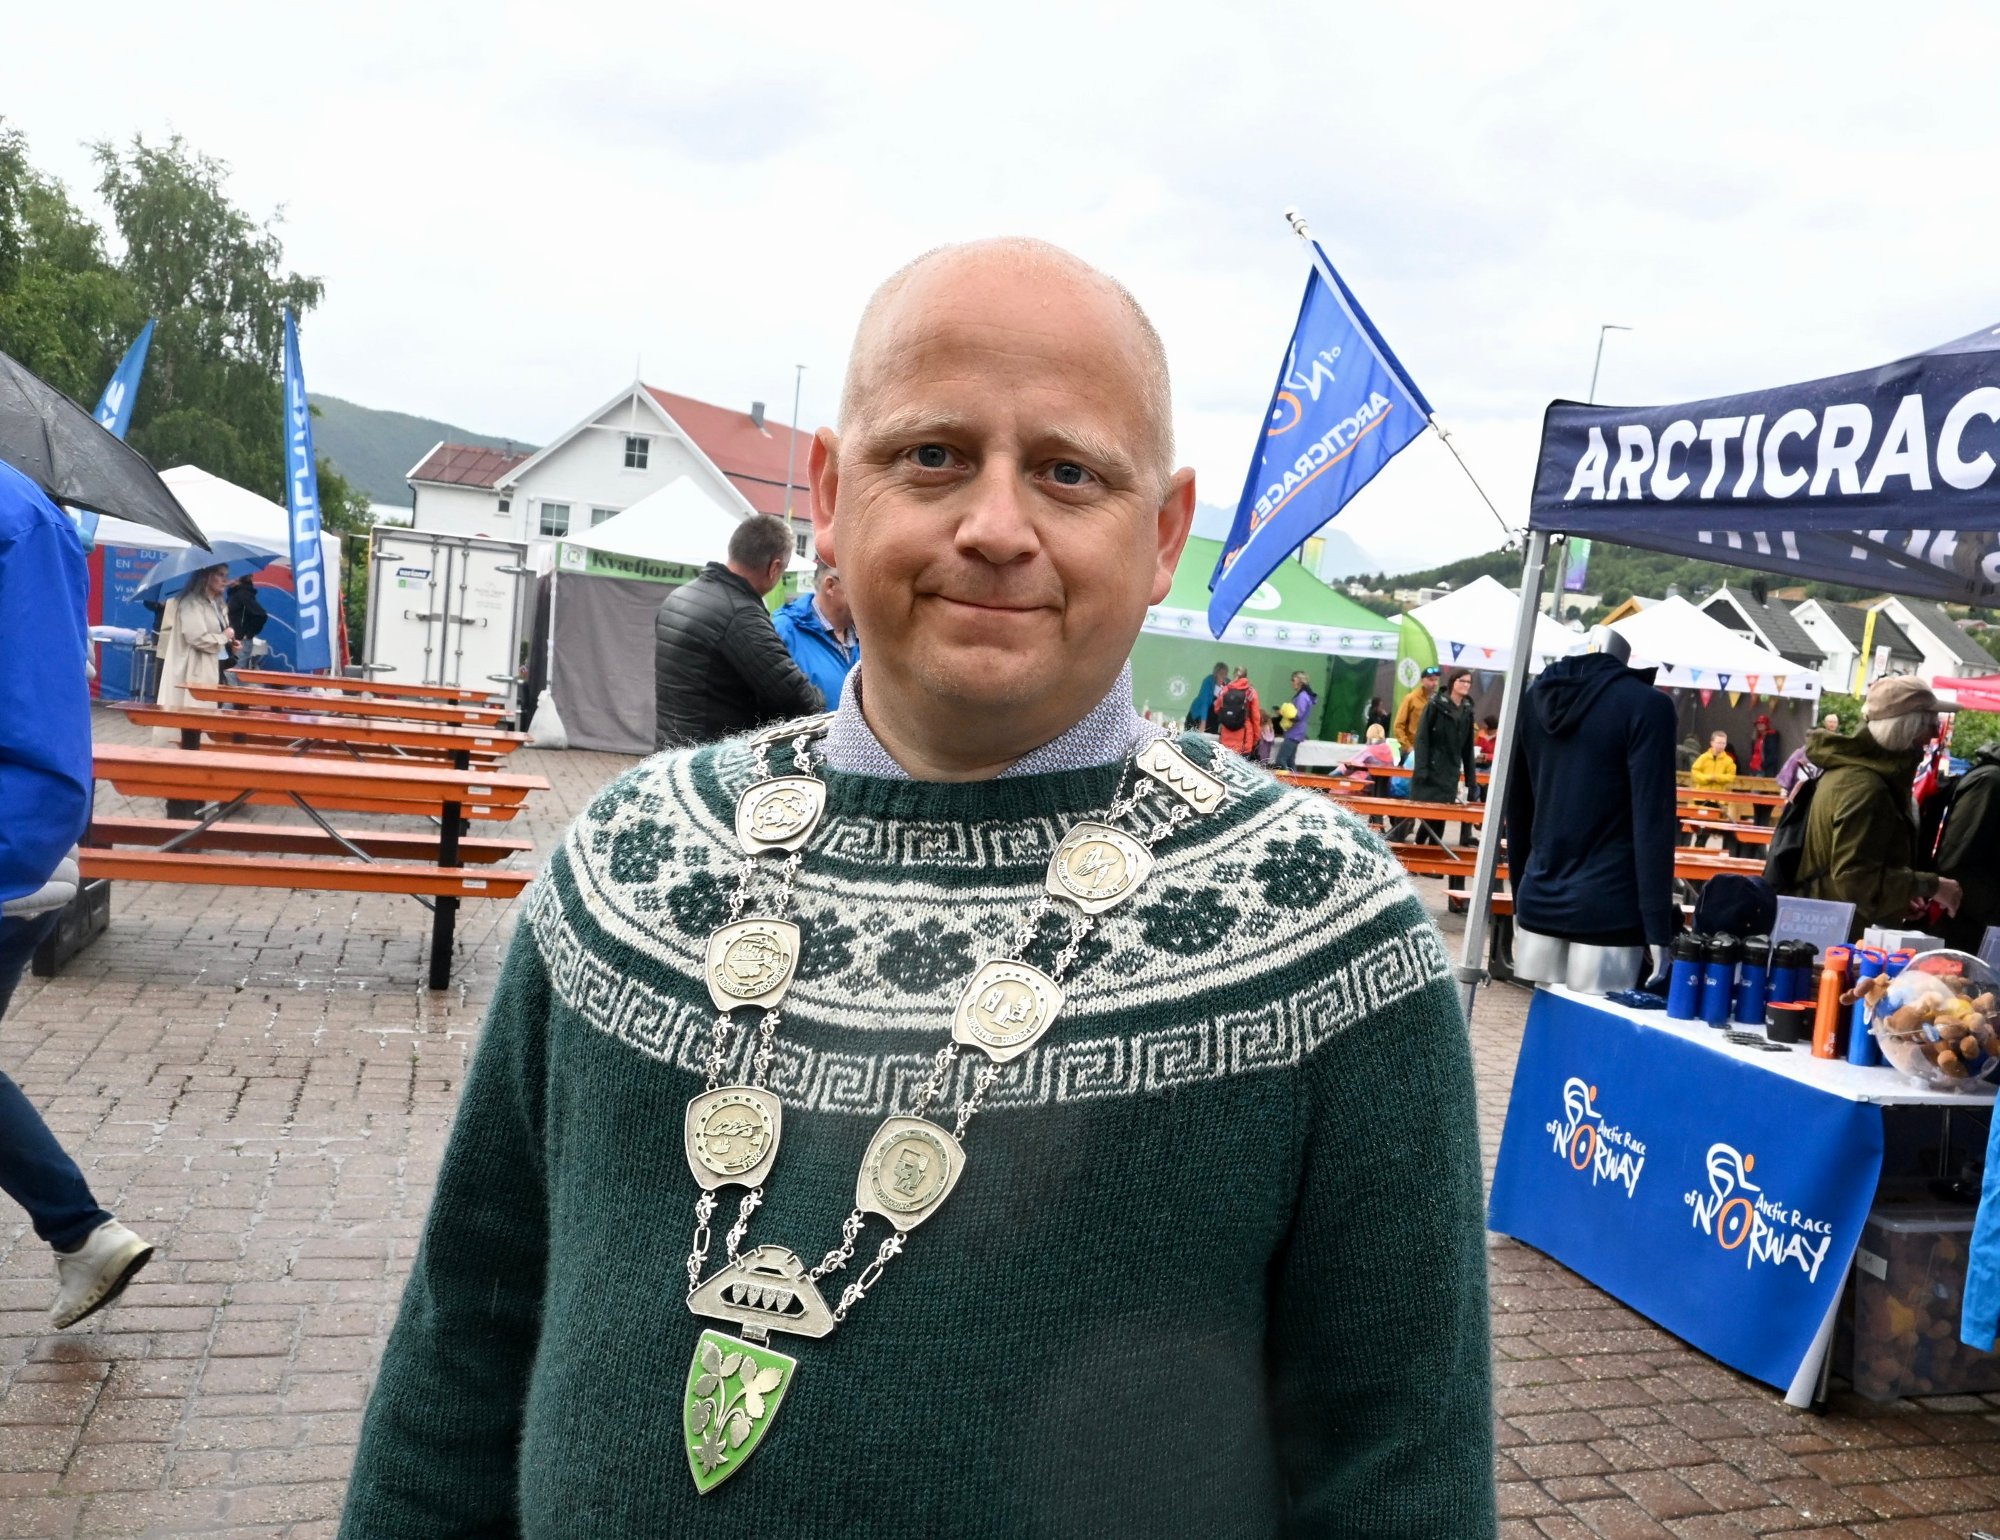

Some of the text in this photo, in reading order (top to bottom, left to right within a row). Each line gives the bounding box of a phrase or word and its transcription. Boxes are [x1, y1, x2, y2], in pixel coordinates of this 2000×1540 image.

[592, 551, 684, 579] Kvæfjord
[1597, 1119, 1622, 1144] Arctic
[1546, 1119, 1645, 1199] of NORWAY
[1754, 1193, 1788, 1223] Arctic
[1684, 1190, 1832, 1283] of NORWAY
